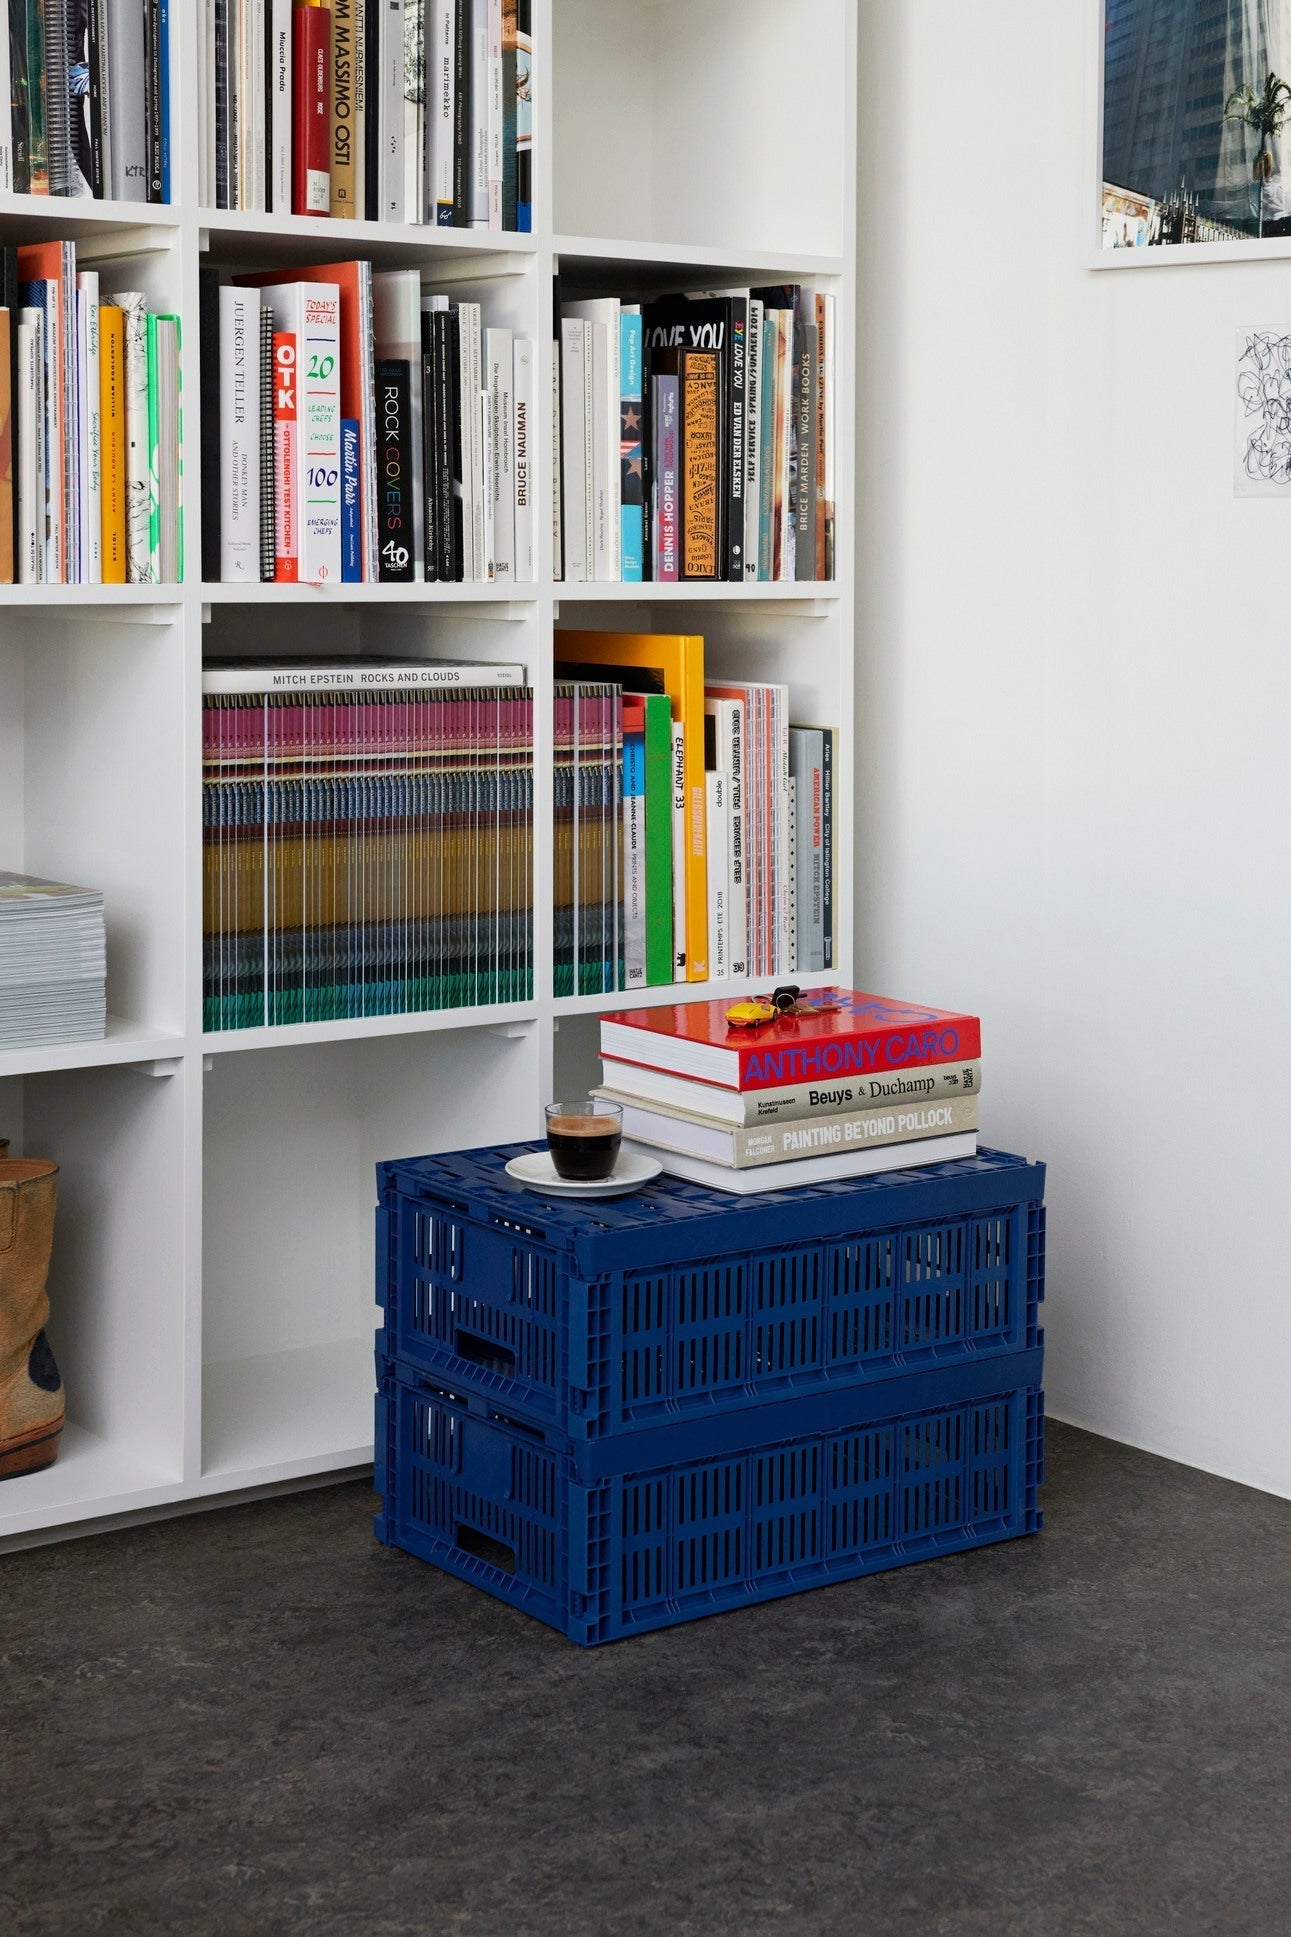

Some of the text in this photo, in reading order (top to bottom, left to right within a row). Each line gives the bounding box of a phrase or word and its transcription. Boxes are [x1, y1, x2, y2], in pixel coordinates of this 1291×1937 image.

[356, 2, 364, 112] ANTTI NURMESNIEMI
[335, 0, 350, 166] M MASSIMO OSTI
[126, 166, 146, 177] KTR
[306, 300, 336, 311] TODAY'S
[306, 314, 336, 324] SPECIAL
[89, 321, 98, 356] Ethridge
[690, 322, 724, 349] YOU
[234, 301, 245, 424] JUERGEN TELLER
[306, 355, 335, 380] 20
[734, 321, 743, 389] EYE LOVE YOU
[276, 345, 295, 408] OTK
[802, 354, 810, 393] BOOKS
[308, 404, 336, 414] LEADING
[311, 414, 332, 423] CHEFS
[385, 387, 399, 441] ROCK
[819, 402, 824, 410] by
[310, 433, 334, 441] CHOOSE
[518, 402, 526, 506] BRUCE NAUMAN
[733, 402, 742, 498] ED VAN DER ELSKEN
[306, 468, 338, 487] 100
[344, 429, 357, 505] Martin Parr
[91, 471, 99, 491] Body
[386, 448, 401, 529] COVERS
[664, 471, 674, 572] DENNIS HOPPER
[382, 540, 409, 564] 40
[273, 674, 354, 685] MITCH EPSTEIN
[361, 672, 460, 683] ROCKS AND CLOUDS
[732, 710, 740, 735] 2013
[675, 737, 685, 809] ELEPHANT 33
[733, 962, 745, 973] 39
[745, 1028, 960, 1082] ANTHONY CARO
[757, 1098, 796, 1107] Kunstmuseen
[809, 1078, 935, 1106] Beuys & Duchamp
[757, 1107, 779, 1116] Krefeld
[748, 1136, 772, 1146] MORGAN
[783, 1107, 952, 1151] PAINTING BEYOND POLLOCK
[745, 1145, 776, 1157] FALCONER
